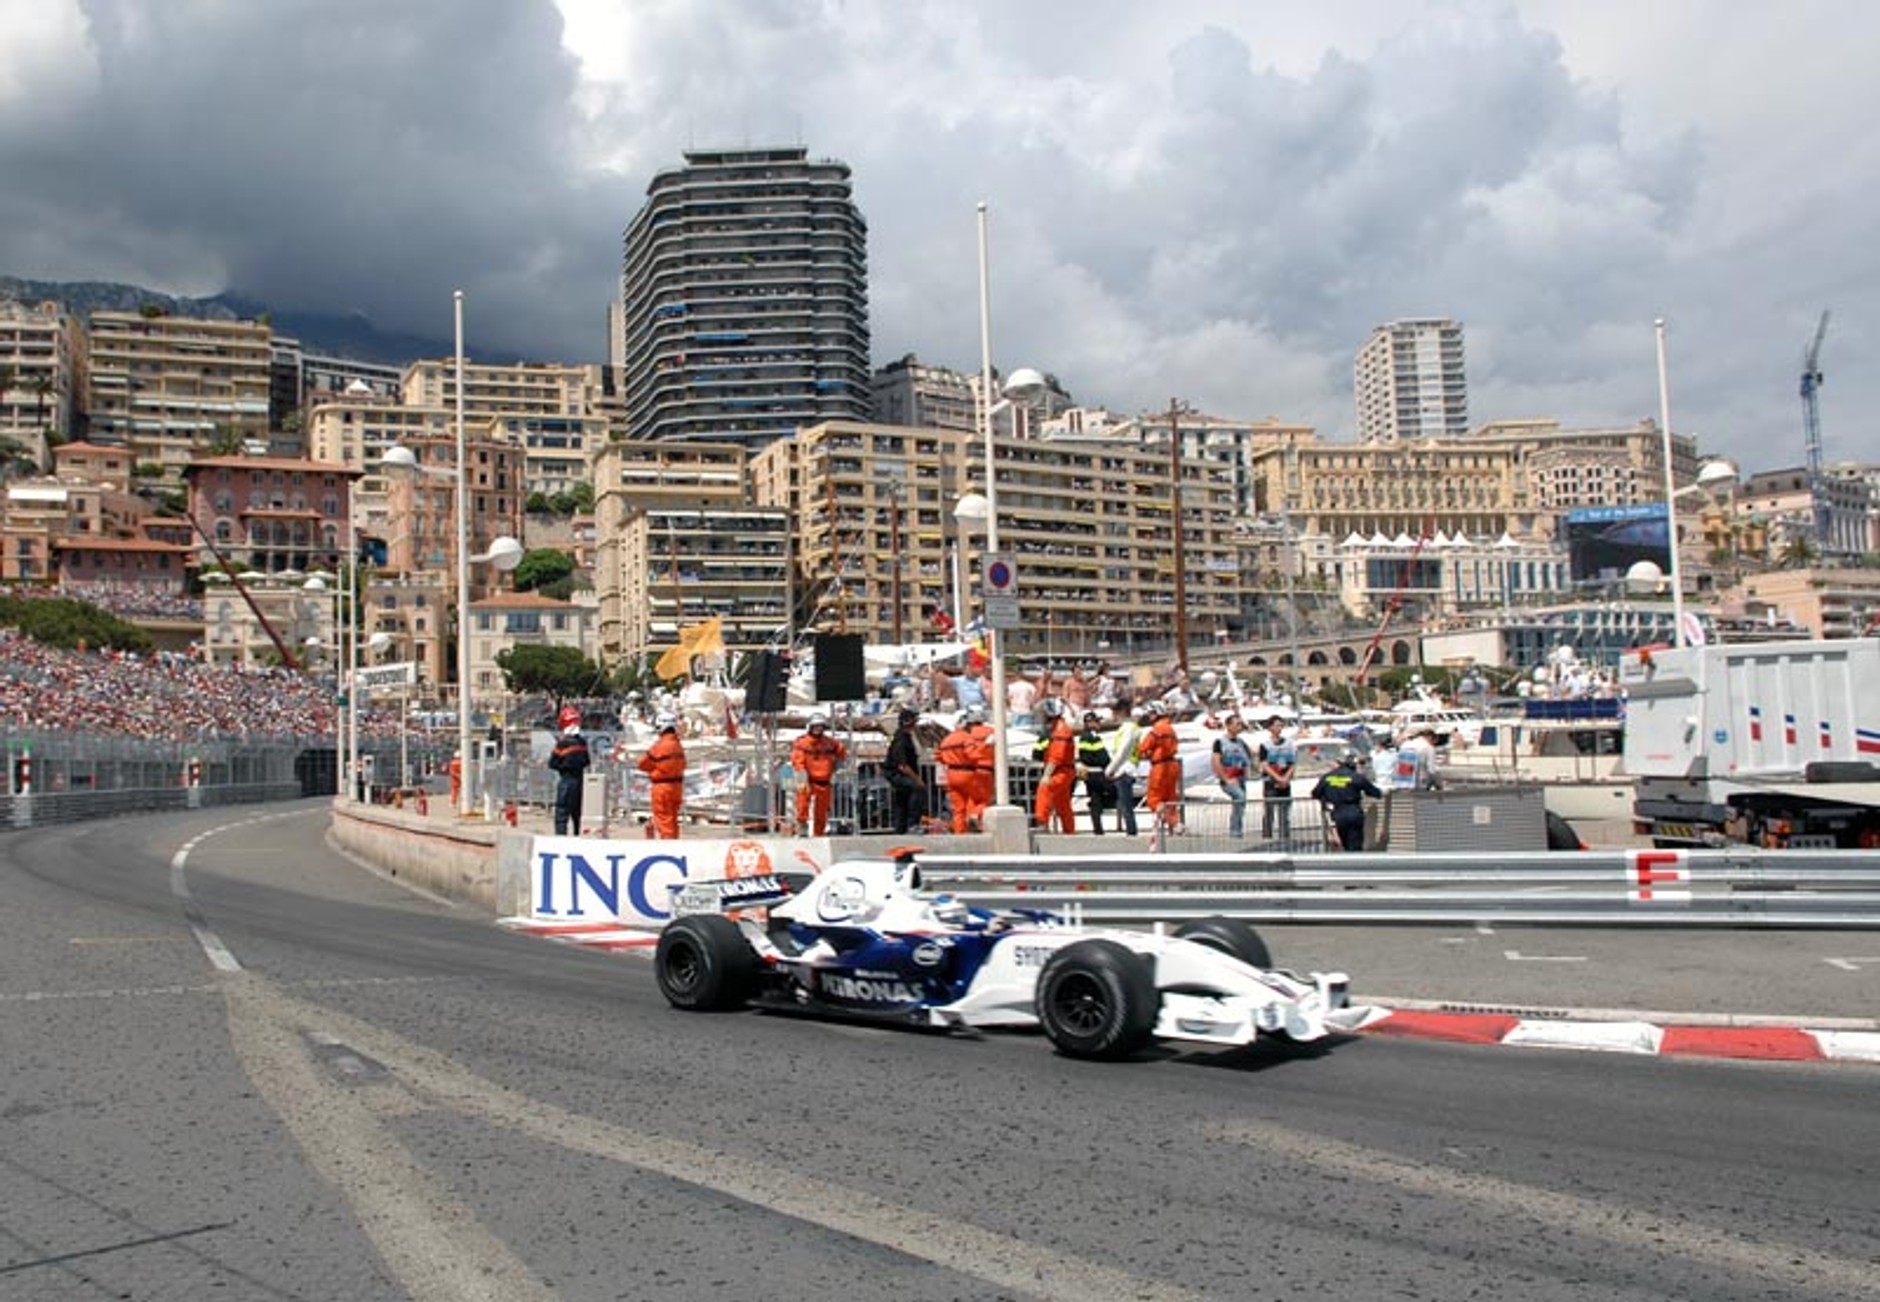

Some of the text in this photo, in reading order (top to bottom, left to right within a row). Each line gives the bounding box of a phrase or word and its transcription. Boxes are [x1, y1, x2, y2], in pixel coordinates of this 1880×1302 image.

[536, 852, 688, 920] ING
[1637, 853, 1678, 900] F
[821, 972, 925, 1003] PETRONAS
